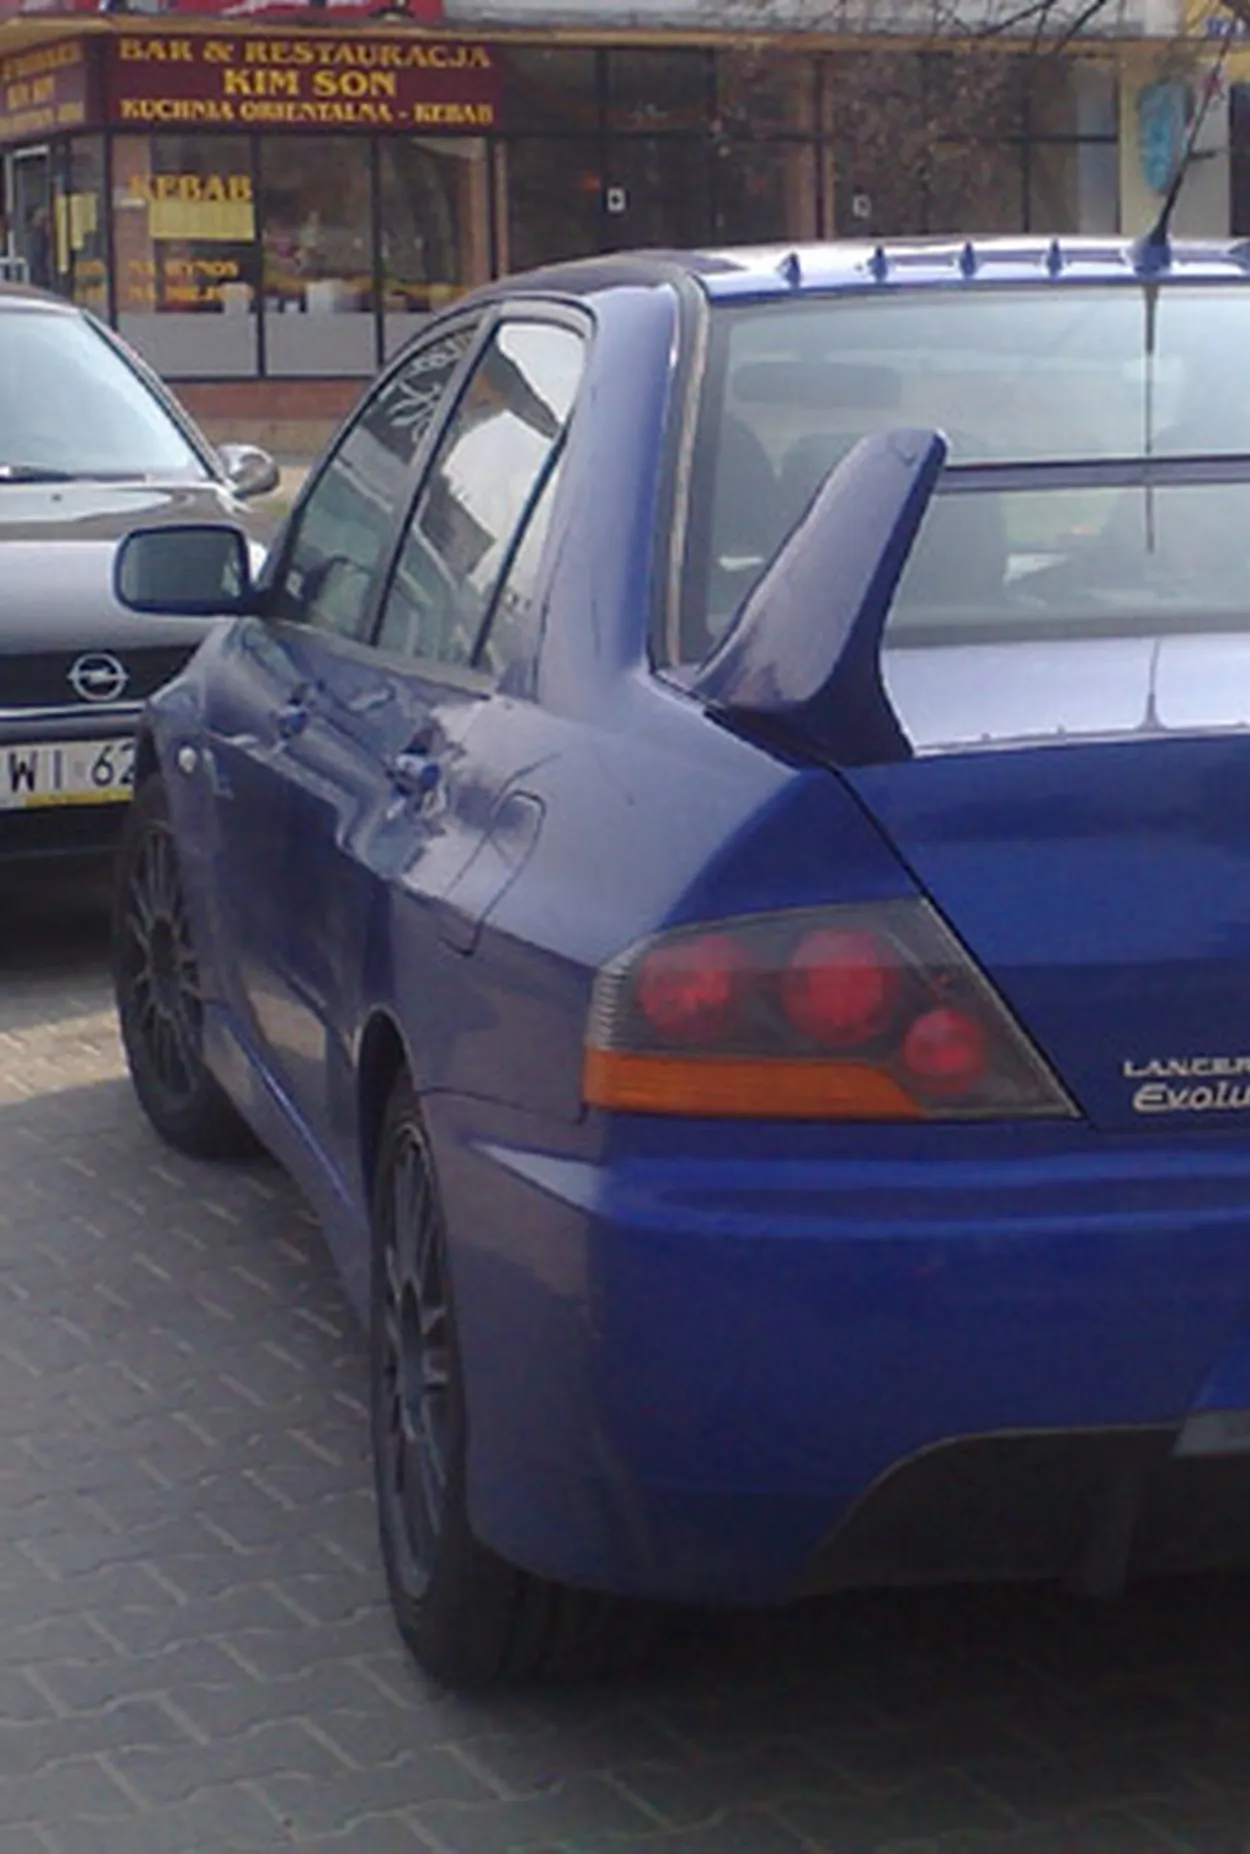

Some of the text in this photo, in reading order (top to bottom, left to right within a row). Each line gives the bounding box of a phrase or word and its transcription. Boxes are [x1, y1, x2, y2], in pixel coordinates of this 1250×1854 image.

[120, 39, 491, 68] BAR & RESTAURACJA
[224, 69, 396, 97] KIM SON
[121, 100, 235, 121] KUCHNIA
[239, 101, 393, 122] ORIENTALNA
[414, 103, 493, 124] KEBAB
[127, 174, 253, 201] KEBAB
